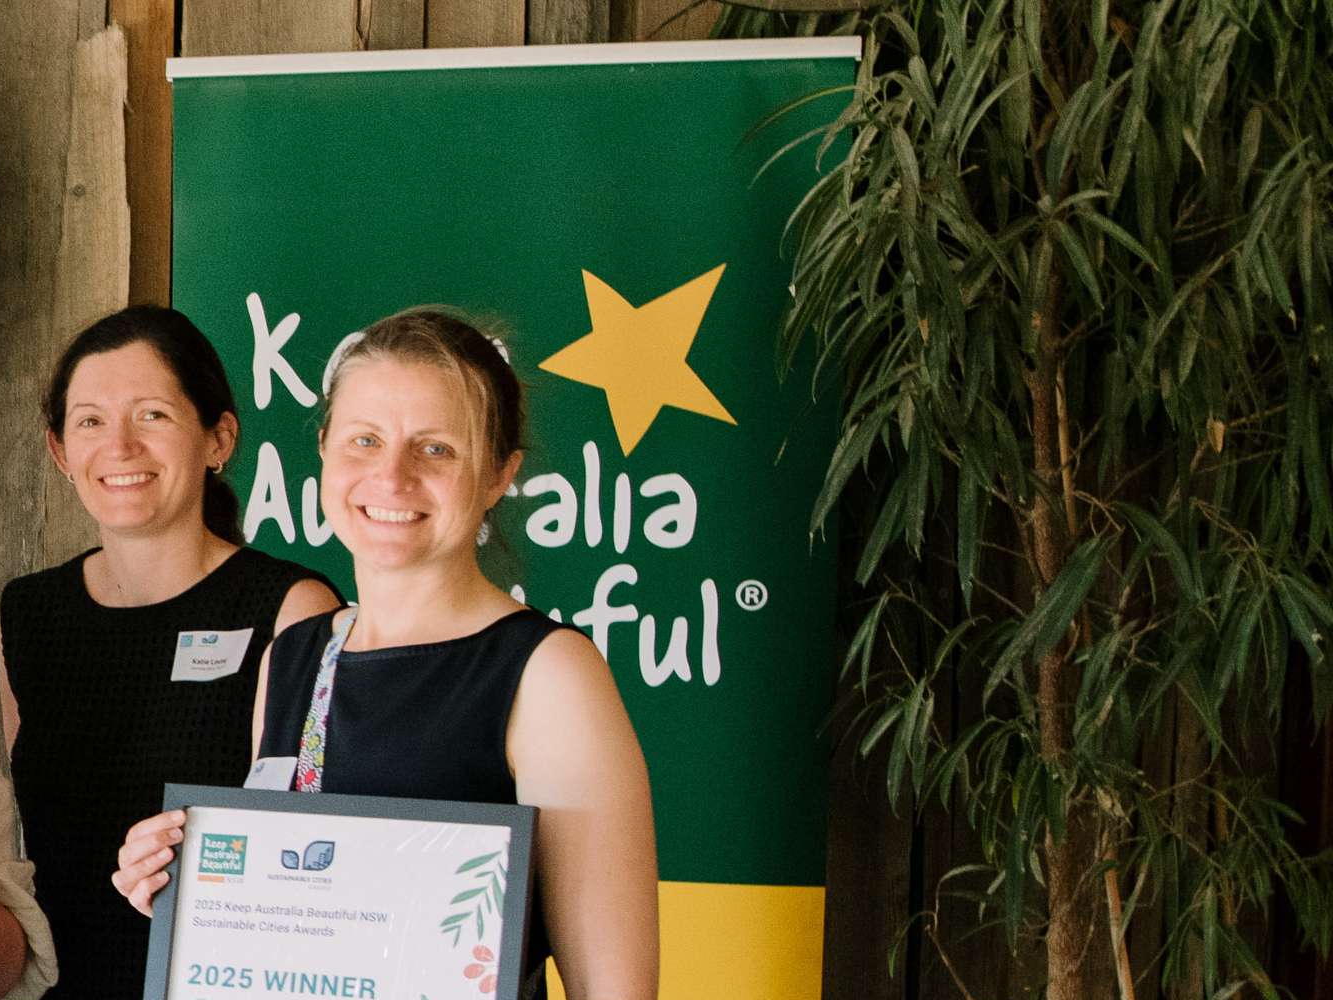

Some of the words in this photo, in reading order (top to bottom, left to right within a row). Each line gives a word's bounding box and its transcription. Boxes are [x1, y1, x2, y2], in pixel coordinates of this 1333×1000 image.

[244, 440, 698, 554] Aualia
[205, 838, 226, 849] Keep
[202, 859, 242, 871] Beautiful
[203, 850, 240, 860] Australia
[194, 900, 221, 911] 2025
[225, 902, 252, 914] Keep
[255, 904, 303, 917] Australia
[307, 907, 357, 921] Beautiful
[360, 912, 388, 922] NSW
[192, 916, 255, 931] Sustainable
[259, 921, 289, 933] Cities
[293, 924, 335, 937] Awards
[188, 964, 253, 989] 2025
[264, 969, 376, 1000] WINNER
